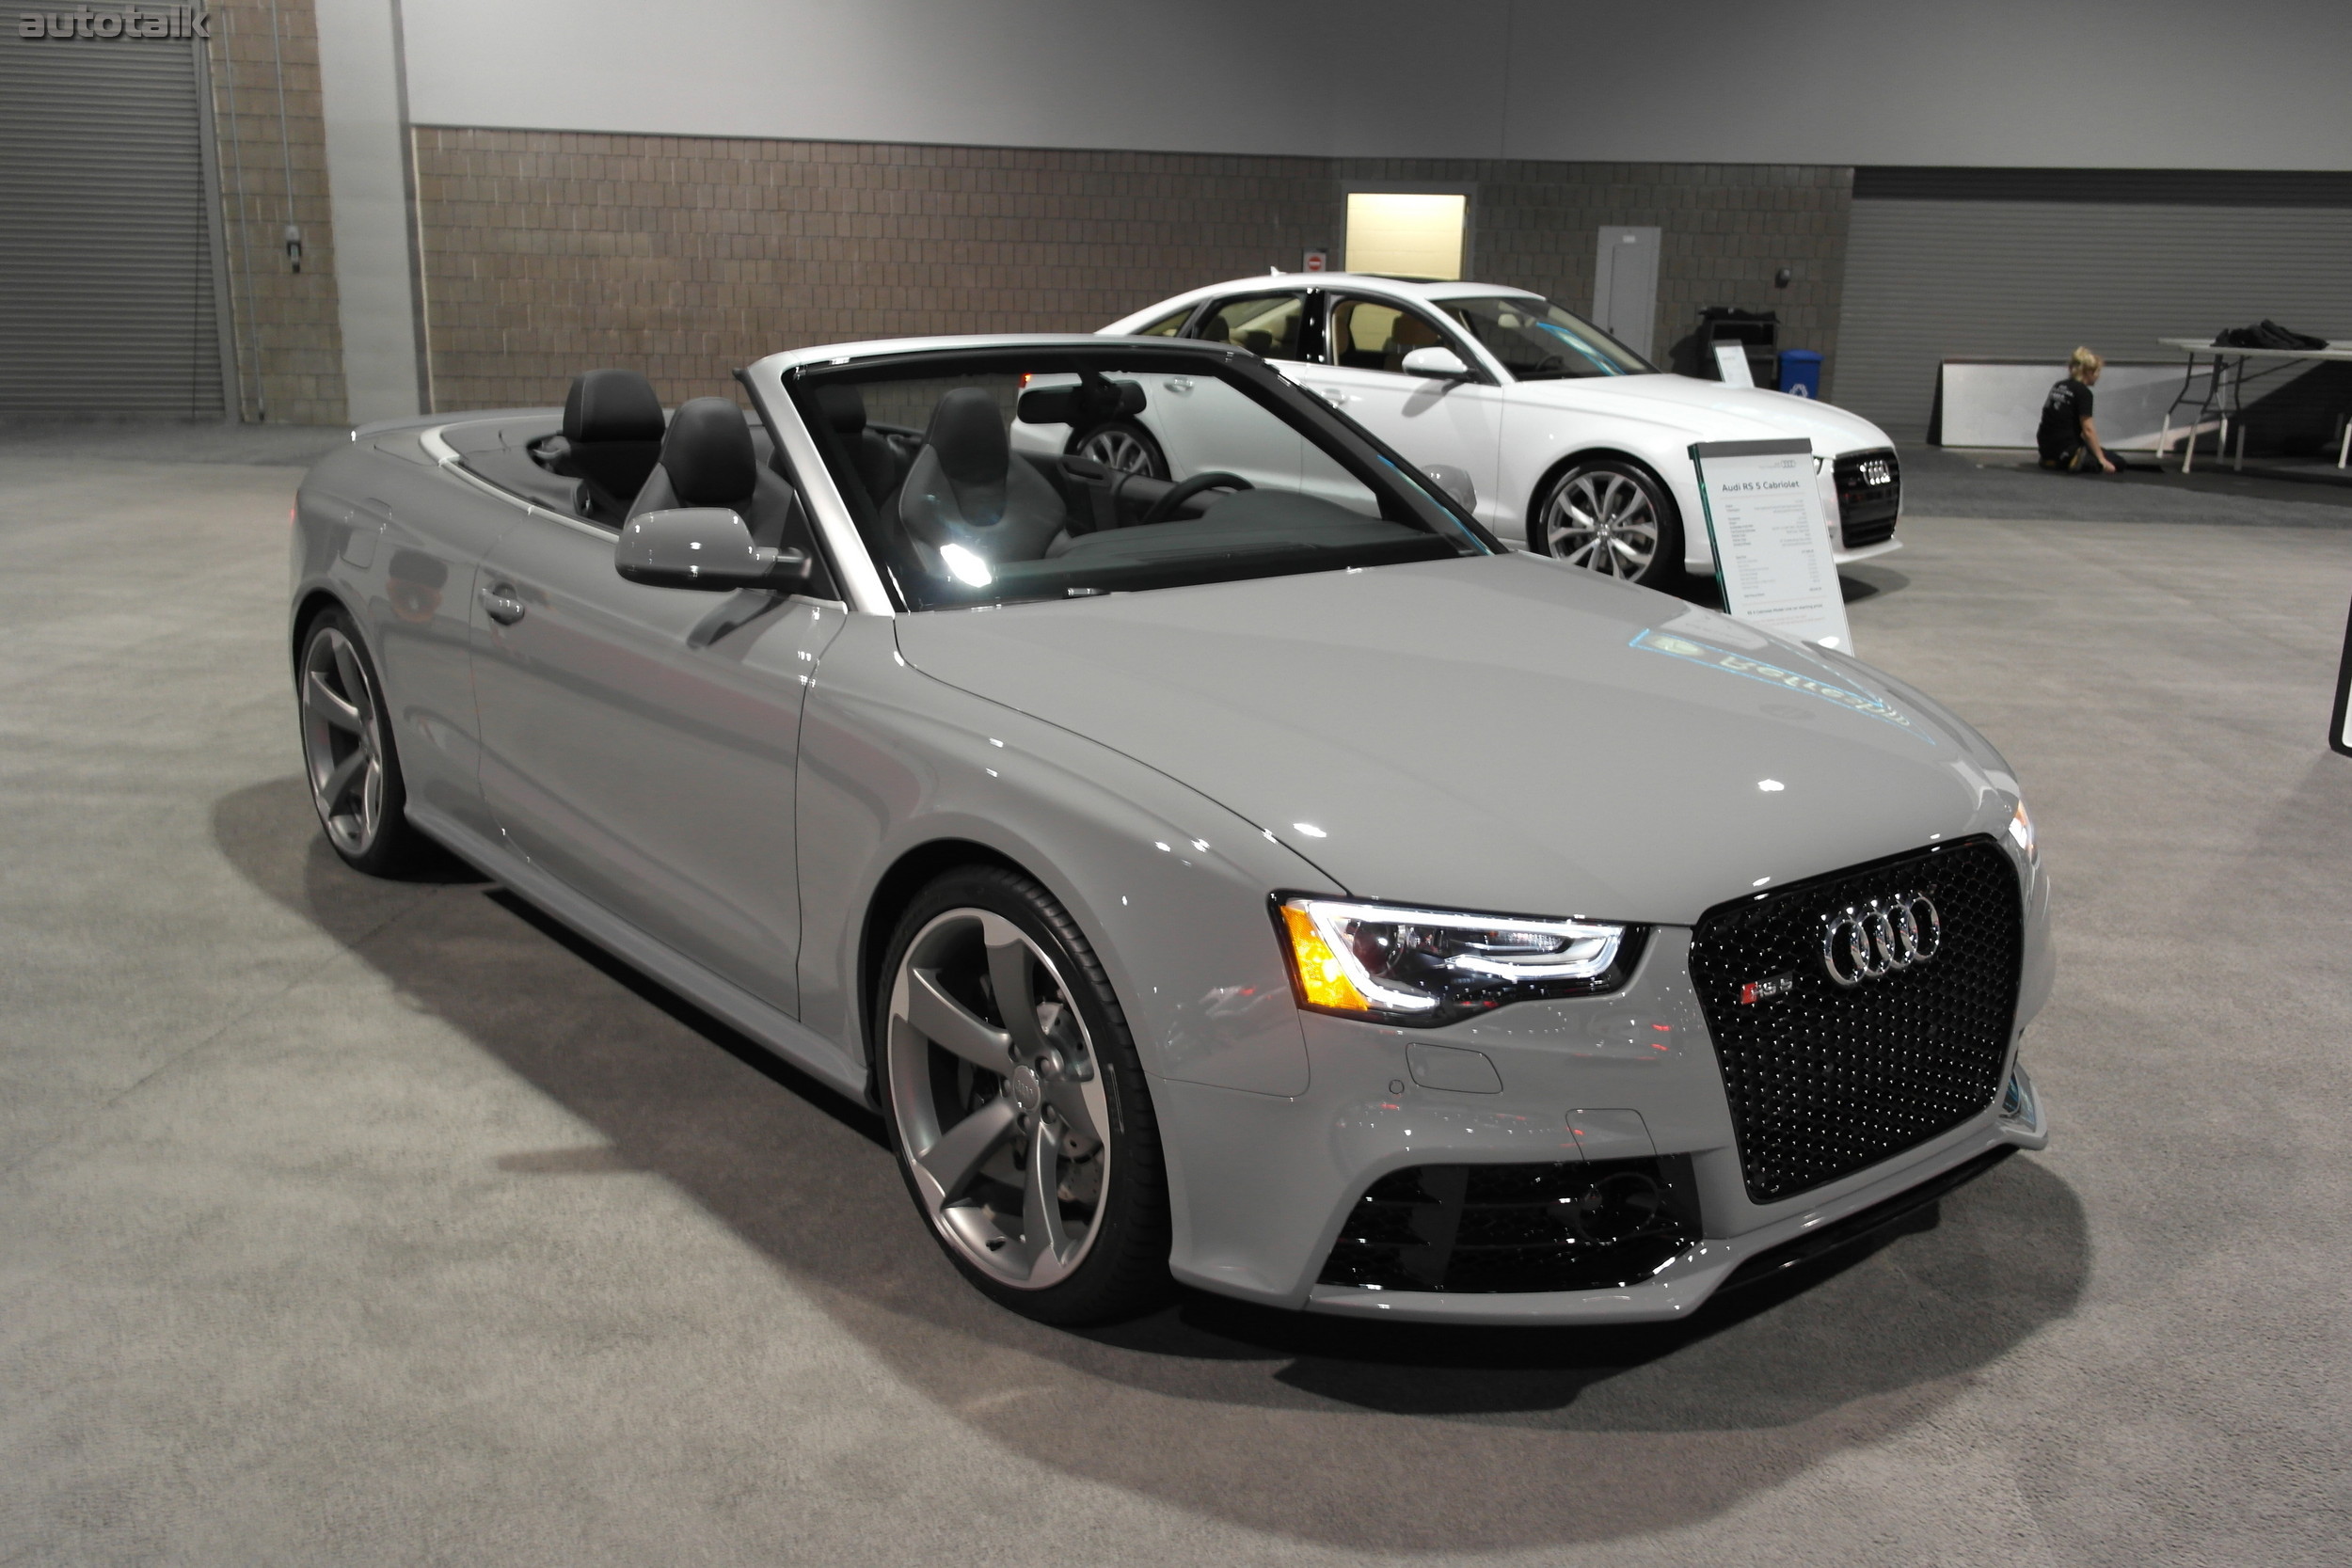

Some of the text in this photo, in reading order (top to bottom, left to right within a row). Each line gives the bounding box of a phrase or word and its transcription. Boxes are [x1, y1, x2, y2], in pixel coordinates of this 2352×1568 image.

[1723, 483, 1740, 492] Audi
[1742, 482, 1754, 490] RS
[1763, 481, 1800, 489] Cabriolet
